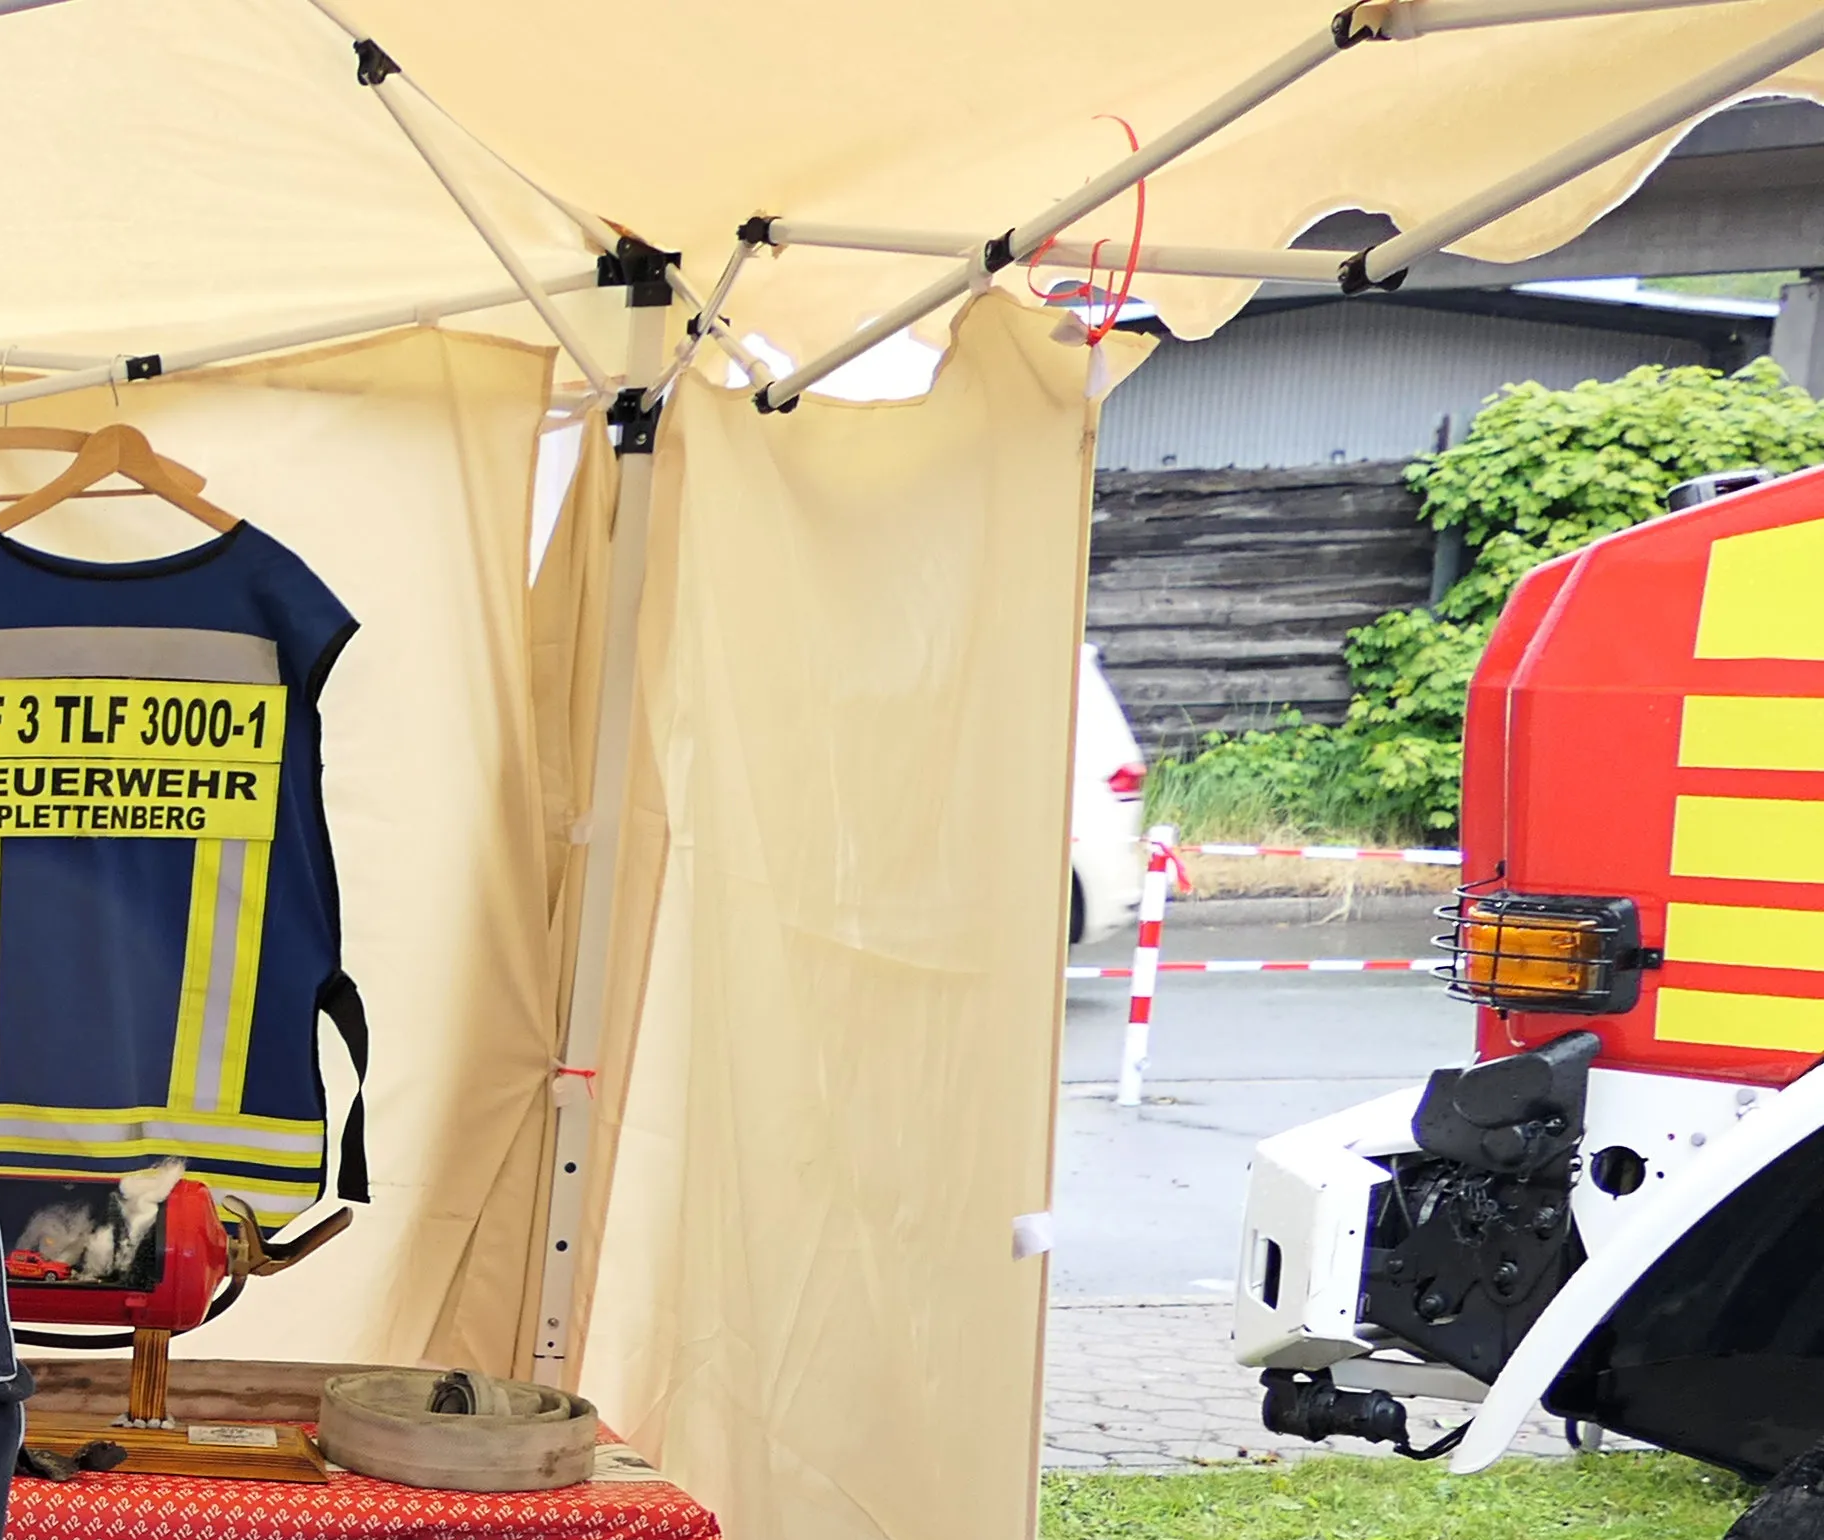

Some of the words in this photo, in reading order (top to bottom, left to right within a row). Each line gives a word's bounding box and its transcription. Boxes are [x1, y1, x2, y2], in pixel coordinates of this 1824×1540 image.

[17, 695, 40, 744] 3
[55, 695, 128, 744] TLF
[140, 697, 267, 749] 3000-1
[90, 1496, 109, 1515] 112
[180, 1502, 199, 1521] 112
[225, 1505, 245, 1524] 112
[425, 1501, 445, 1517] 112
[448, 1502, 468, 1519] 112
[471, 1504, 491, 1520] 112
[494, 1505, 514, 1522] 112
[517, 1506, 537, 1524] 112
[39, 1513, 59, 1532] 112
[61, 1515, 81, 1534] 112
[292, 1510, 313, 1529] 112
[315, 1511, 335, 1531] 112
[384, 1516, 404, 1533] 112
[540, 1507, 560, 1526] 112
[562, 1509, 583, 1527] 112
[585, 1511, 605, 1528] 112
[629, 1515, 649, 1534] 112
[128, 1520, 148, 1539] 112
[651, 1519, 670, 1536] 112
[671, 1524, 690, 1539] 112
